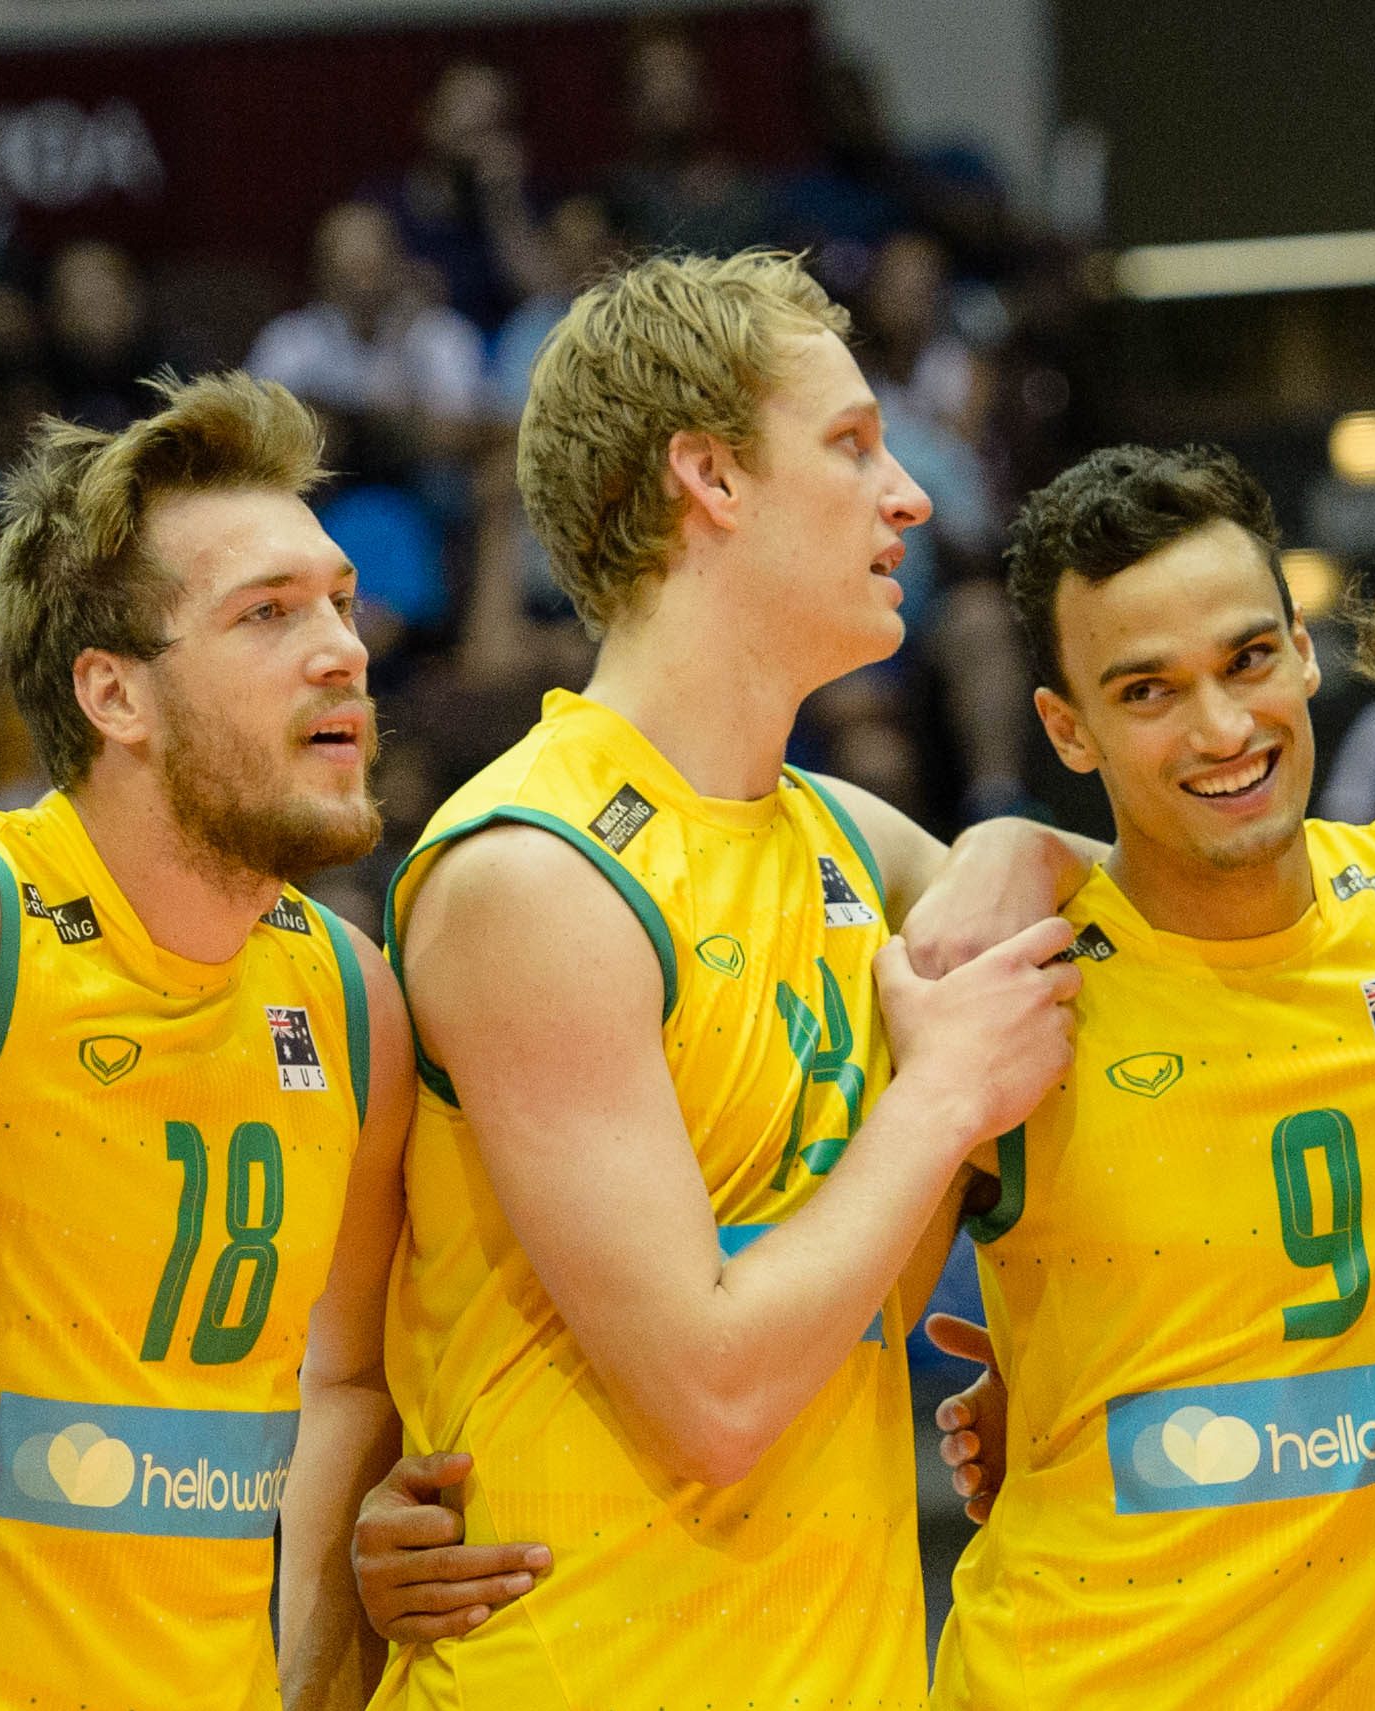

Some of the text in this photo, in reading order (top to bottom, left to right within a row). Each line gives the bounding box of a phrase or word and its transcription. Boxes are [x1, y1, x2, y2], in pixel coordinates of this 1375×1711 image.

[282, 1068, 326, 1087] AUS
[139, 1121, 284, 1365] 18
[1272, 1107, 1371, 1342] 9
